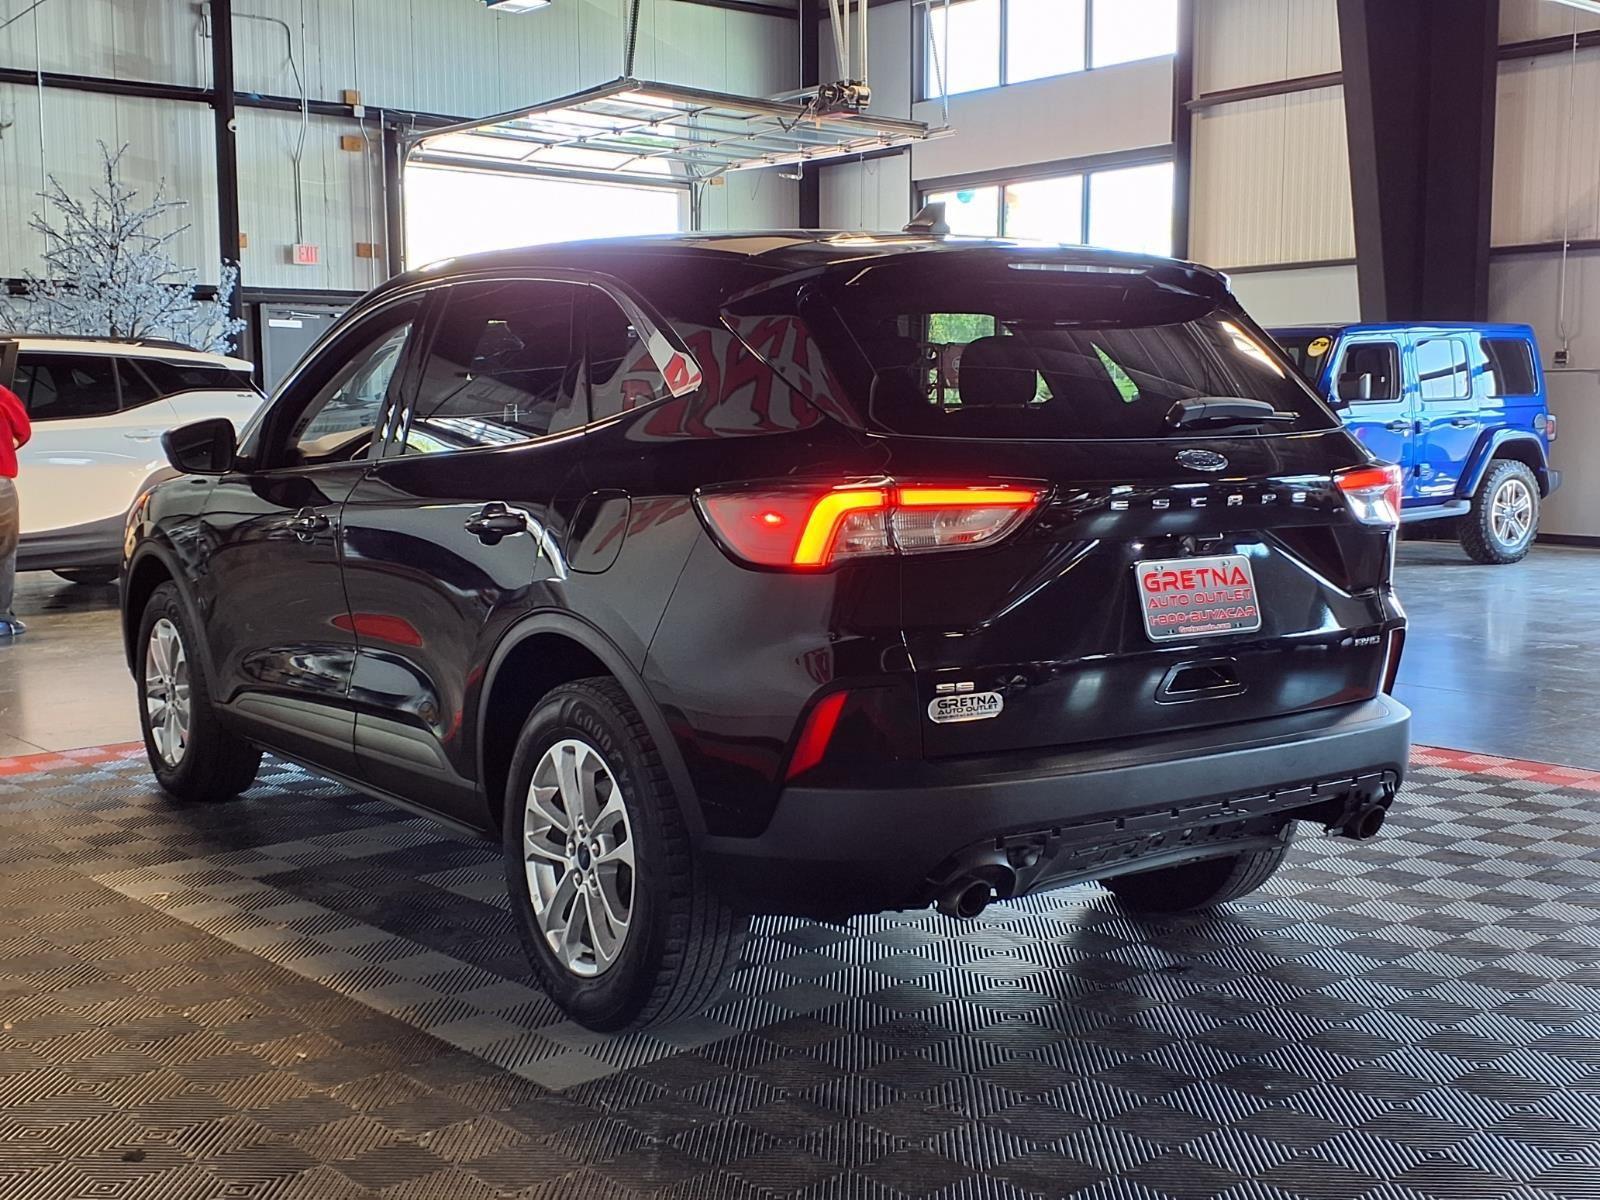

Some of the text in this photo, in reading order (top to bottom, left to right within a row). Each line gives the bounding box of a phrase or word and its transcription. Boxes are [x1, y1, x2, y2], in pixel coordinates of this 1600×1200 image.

[299, 246, 318, 262] EXIT
[1111, 492, 1307, 511] ESCAPE
[1143, 566, 1249, 593] GRETNA
[1148, 588, 1252, 609] AUTO OUTLET
[937, 695, 998, 708] GRETNA
[938, 703, 998, 715] AUTO OUTLET
